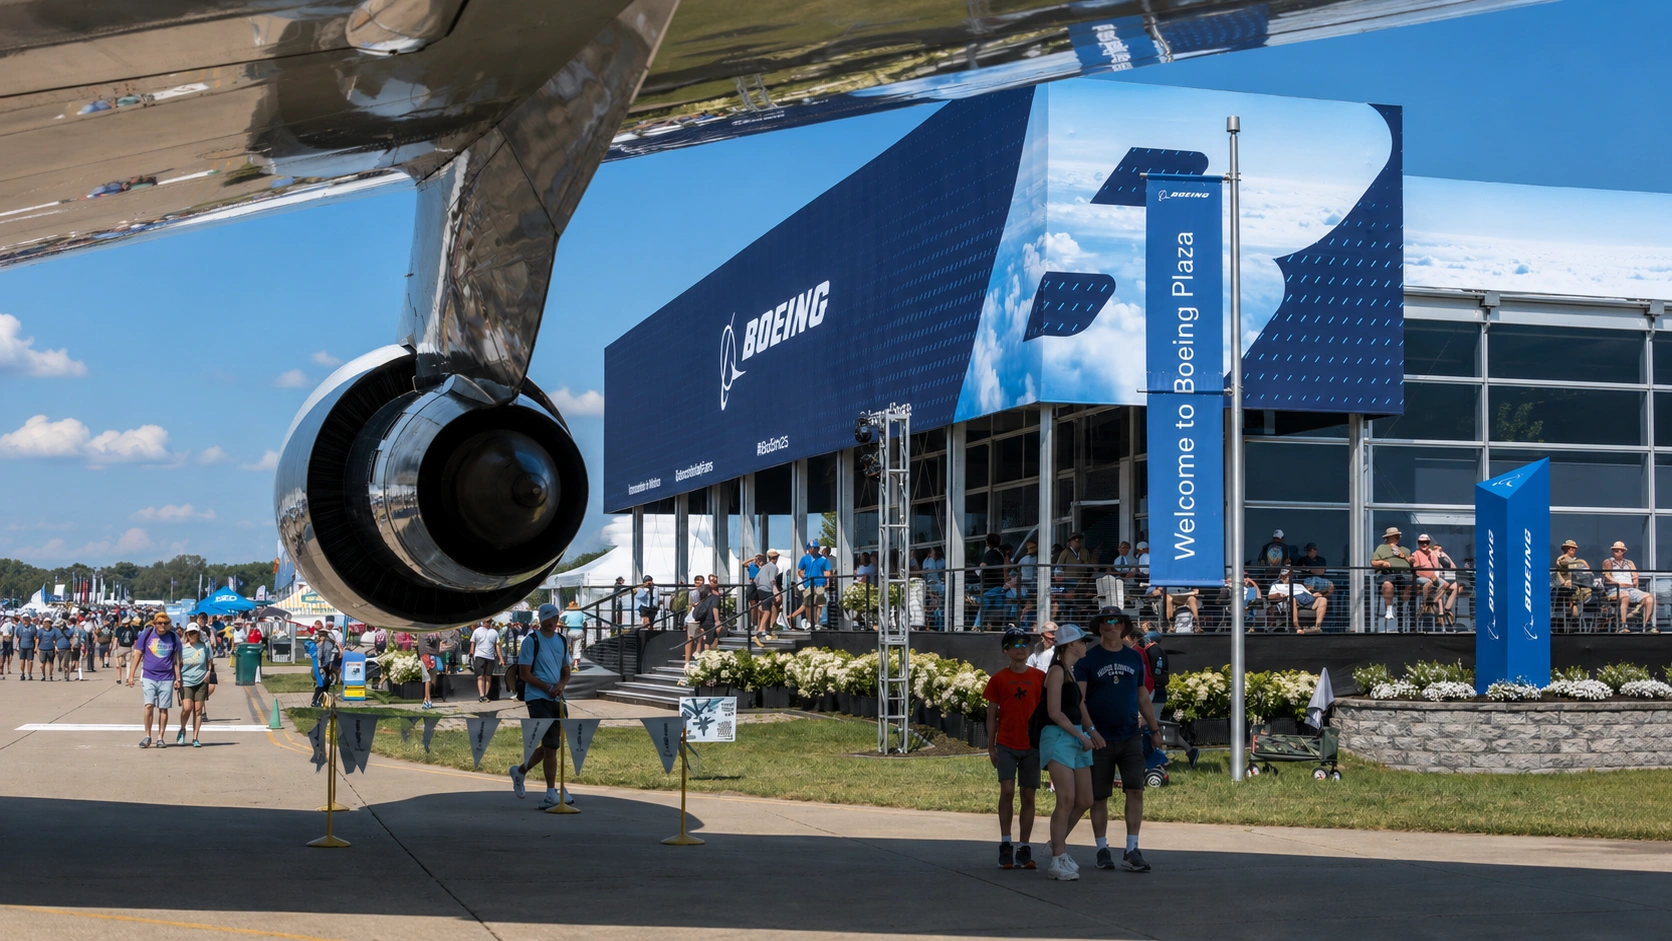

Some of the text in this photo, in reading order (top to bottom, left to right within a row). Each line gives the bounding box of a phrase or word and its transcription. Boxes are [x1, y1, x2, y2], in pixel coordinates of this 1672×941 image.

[1170, 191, 1210, 199] BOEING
[742, 280, 830, 362] BOEING
[1171, 232, 1198, 560] Welcome to Boeing Plaza
[1524, 528, 1532, 613] BOEING
